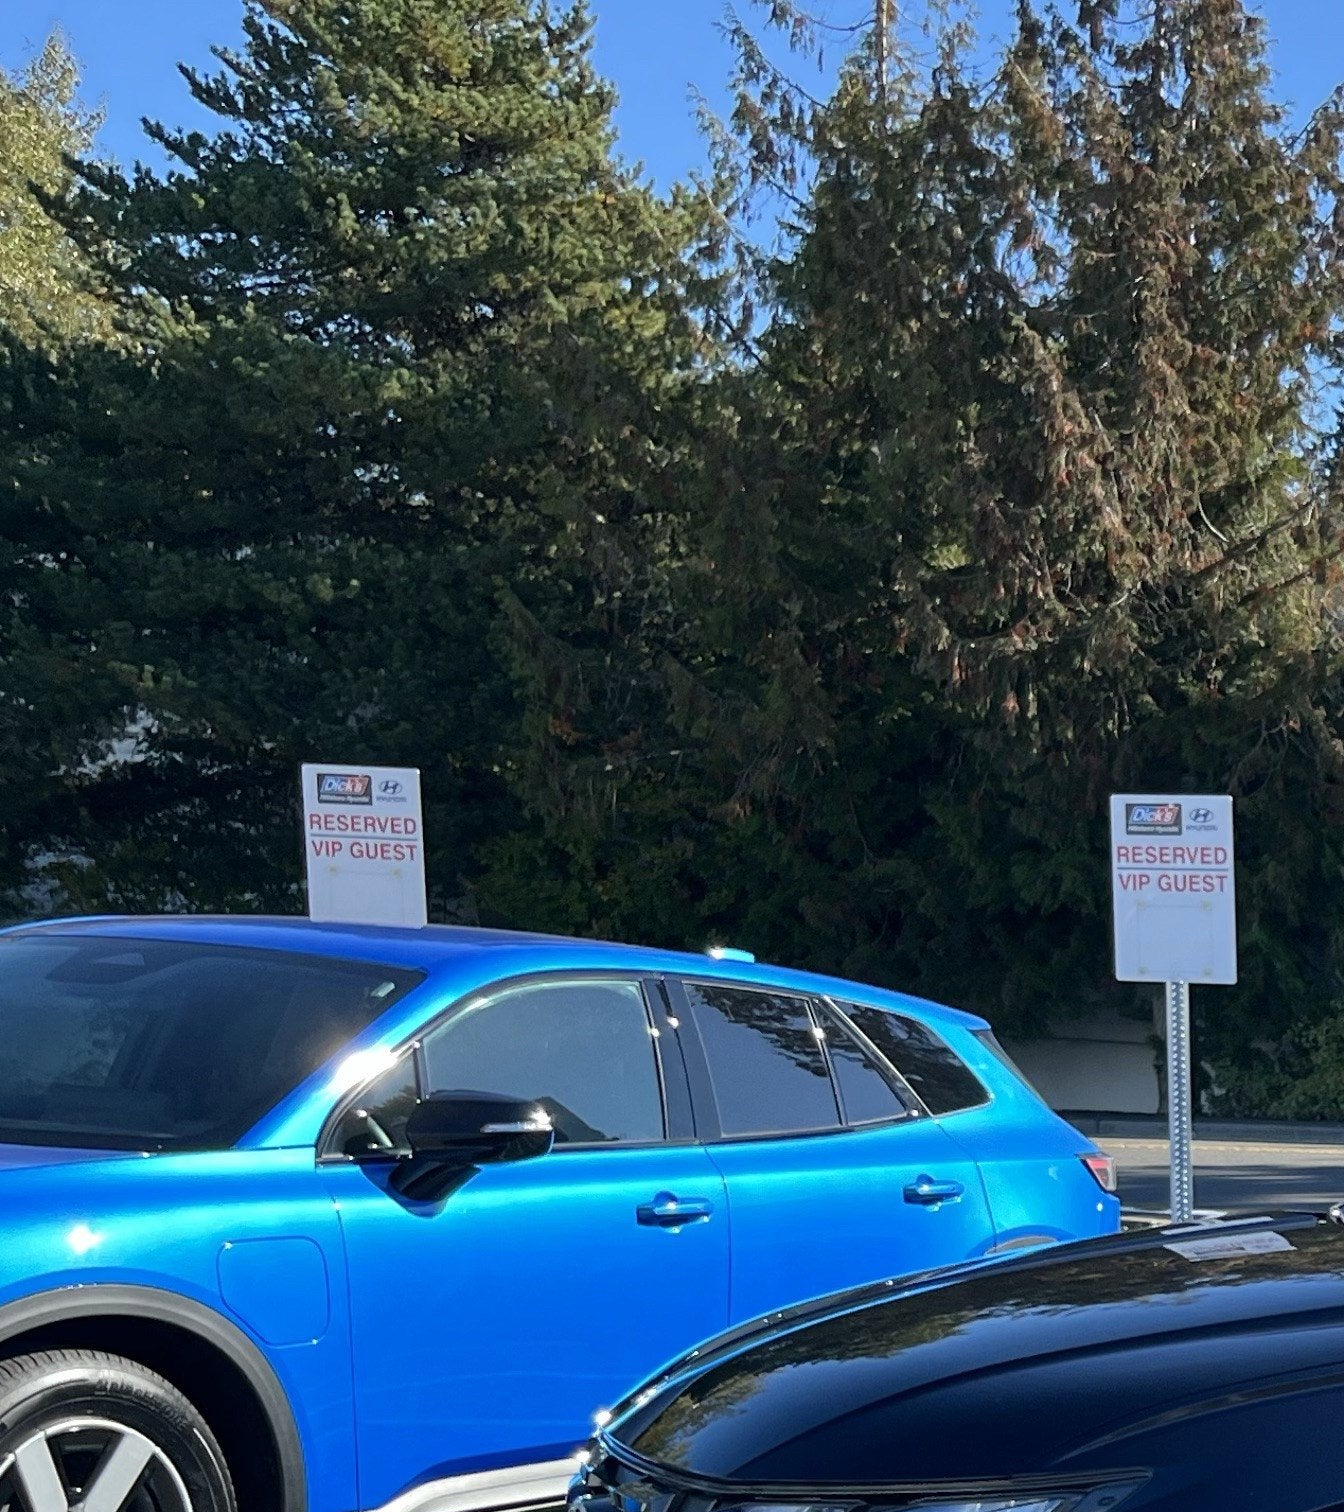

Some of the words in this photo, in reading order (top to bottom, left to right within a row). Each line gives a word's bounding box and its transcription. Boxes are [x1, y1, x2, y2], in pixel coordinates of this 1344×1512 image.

[309, 814, 416, 834] RESERVED
[311, 840, 343, 858] VIP
[350, 842, 417, 861] GUEST
[1116, 846, 1227, 864] RESERVED
[1119, 874, 1150, 891] VIP
[1157, 874, 1228, 893] GUEST
